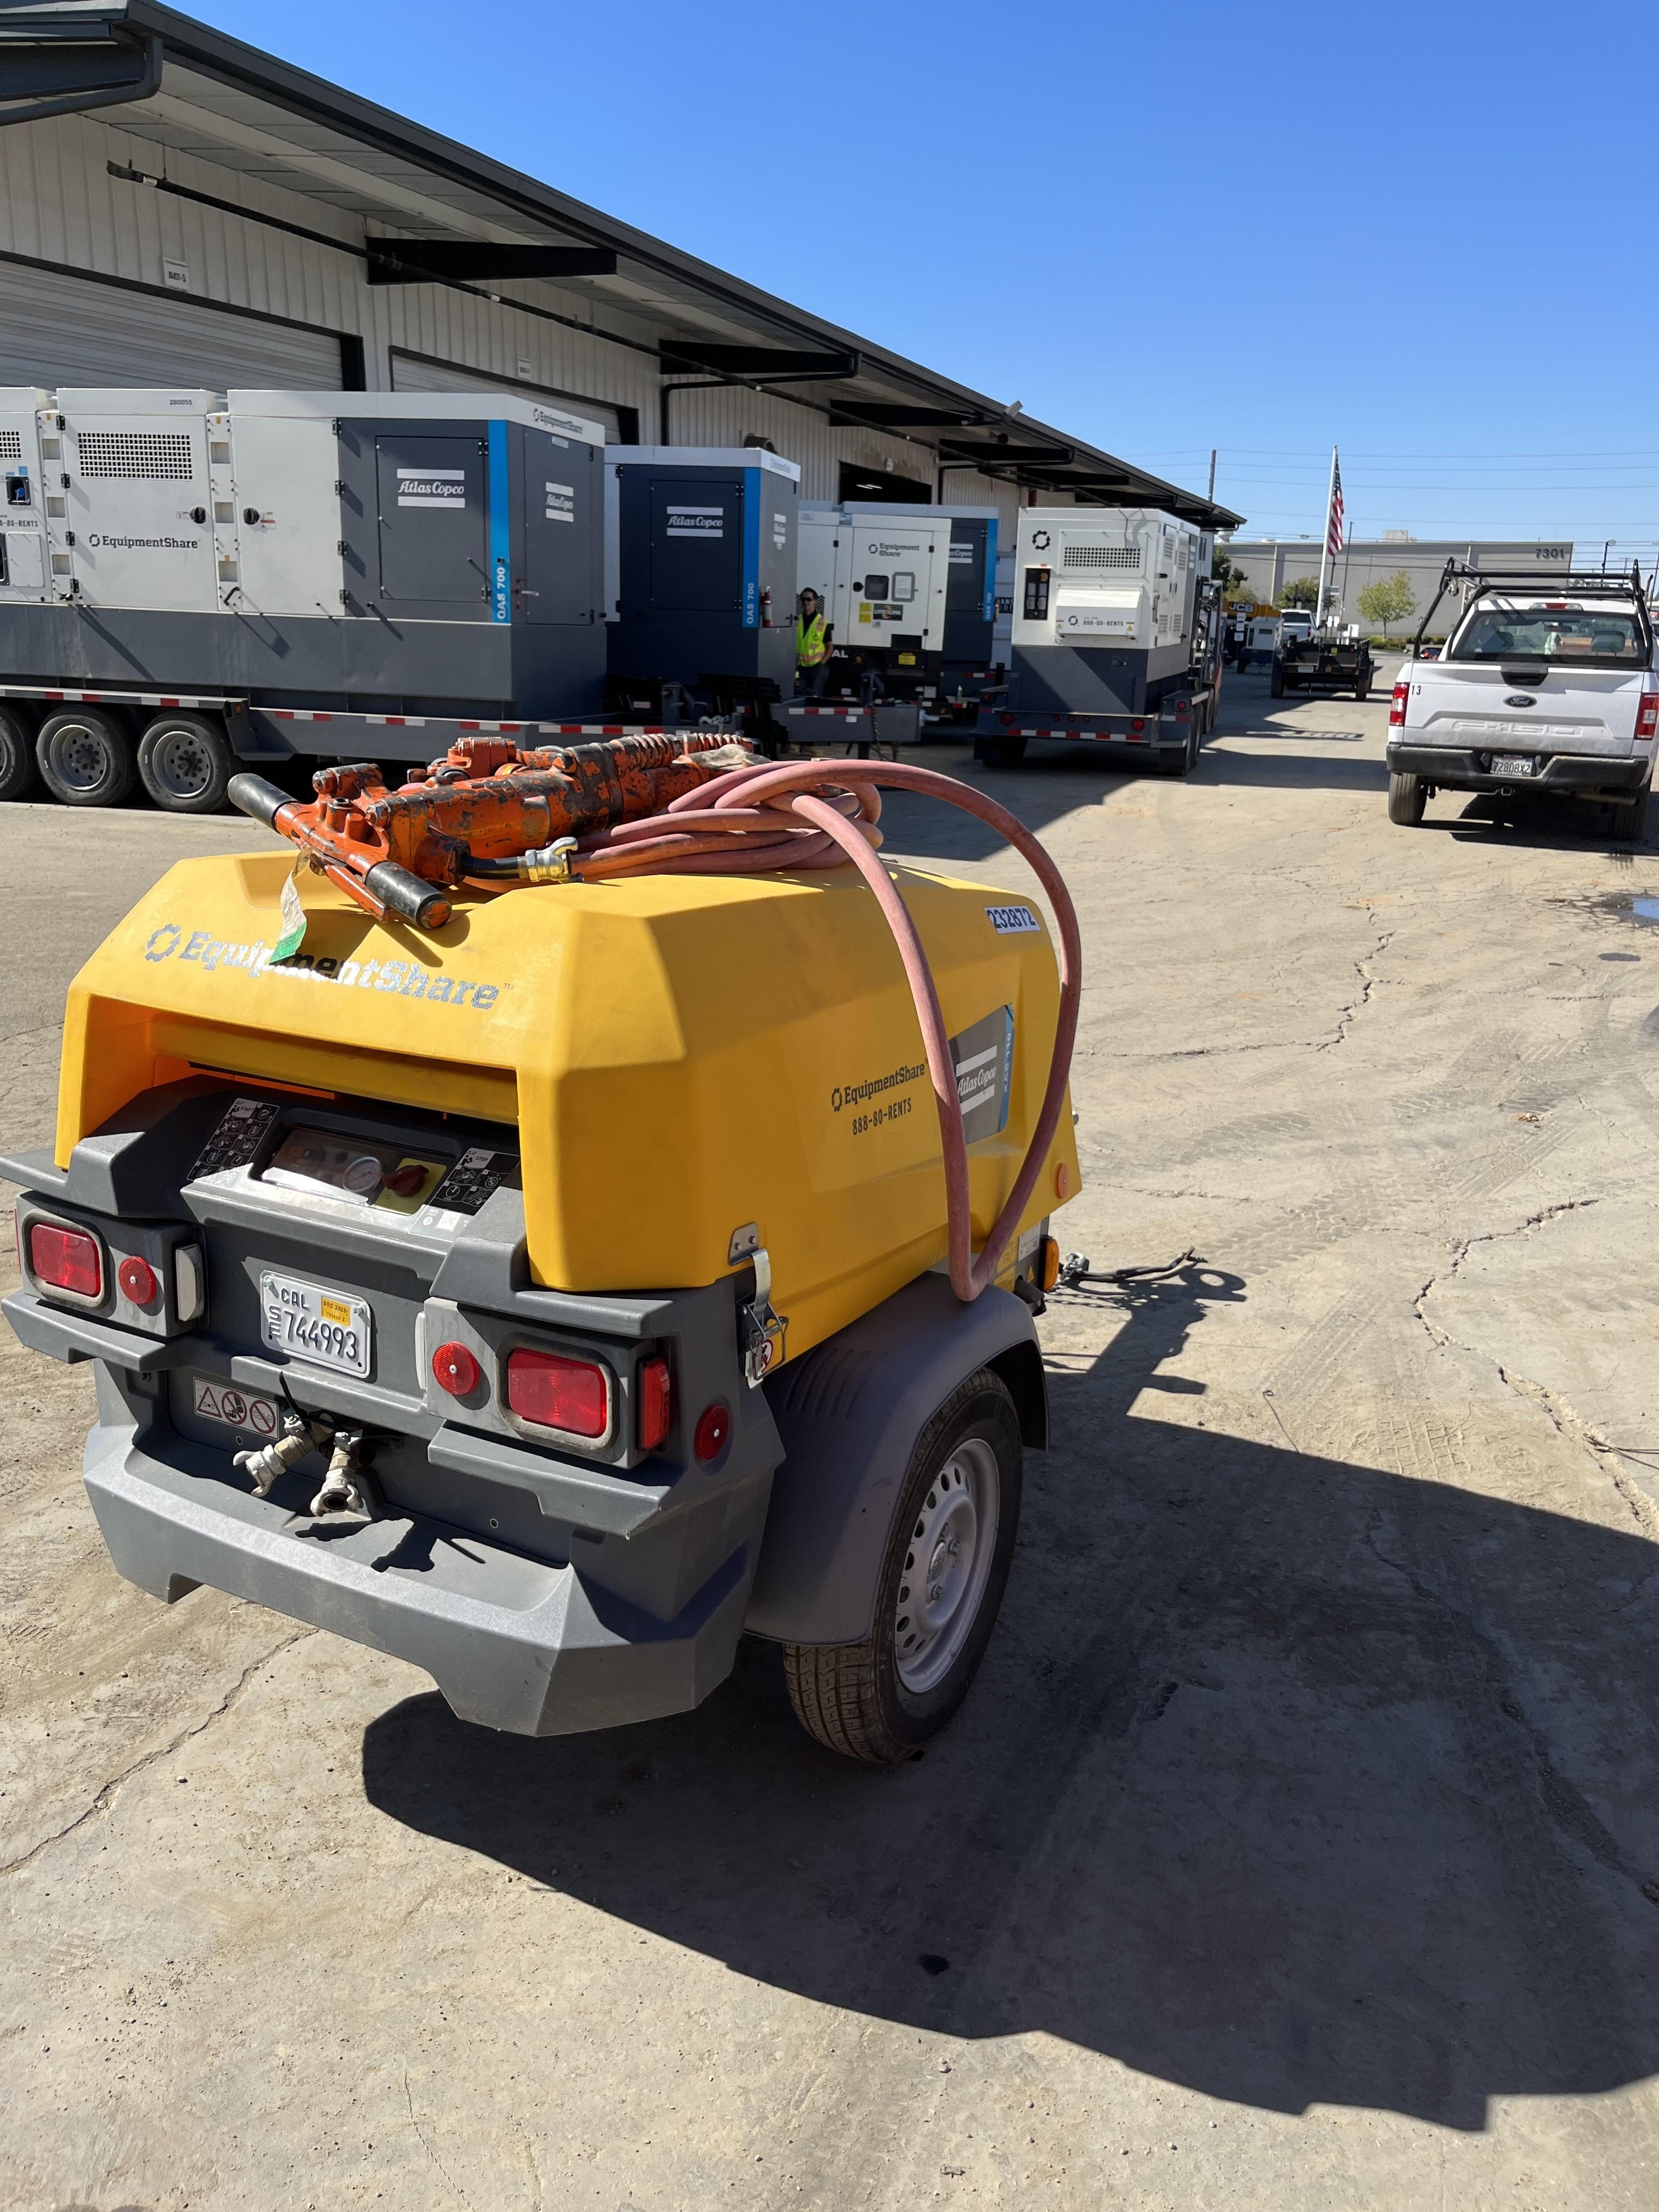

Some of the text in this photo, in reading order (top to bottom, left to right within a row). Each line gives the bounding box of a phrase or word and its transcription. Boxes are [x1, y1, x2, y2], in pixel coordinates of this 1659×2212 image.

[397, 481, 465, 496] Atlas Copco
[667, 515, 724, 529] Atlas Copco
[101, 535, 198, 549] EquipmentShare
[879, 543, 920, 551] Equipment
[1536, 548, 1564, 560] 7301
[496, 567, 506, 620] QAS 700
[746, 603, 754, 624] QAS
[1229, 603, 1253, 612] JCB
[1452, 720, 1584, 738] F-150
[986, 908, 1036, 929] 232872
[178, 930, 499, 1011] EquipmentShare
[844, 1063, 925, 1105] EquipmentShare
[957, 1068, 997, 1097] Atlas Copco
[852, 1097, 912, 1136] 888-80-RENTS
[281, 1288, 311, 1312] CAL
[323, 1300, 334, 1308] DEC
[268, 1305, 281, 1339] SE
[284, 1310, 359, 1360] 744993
